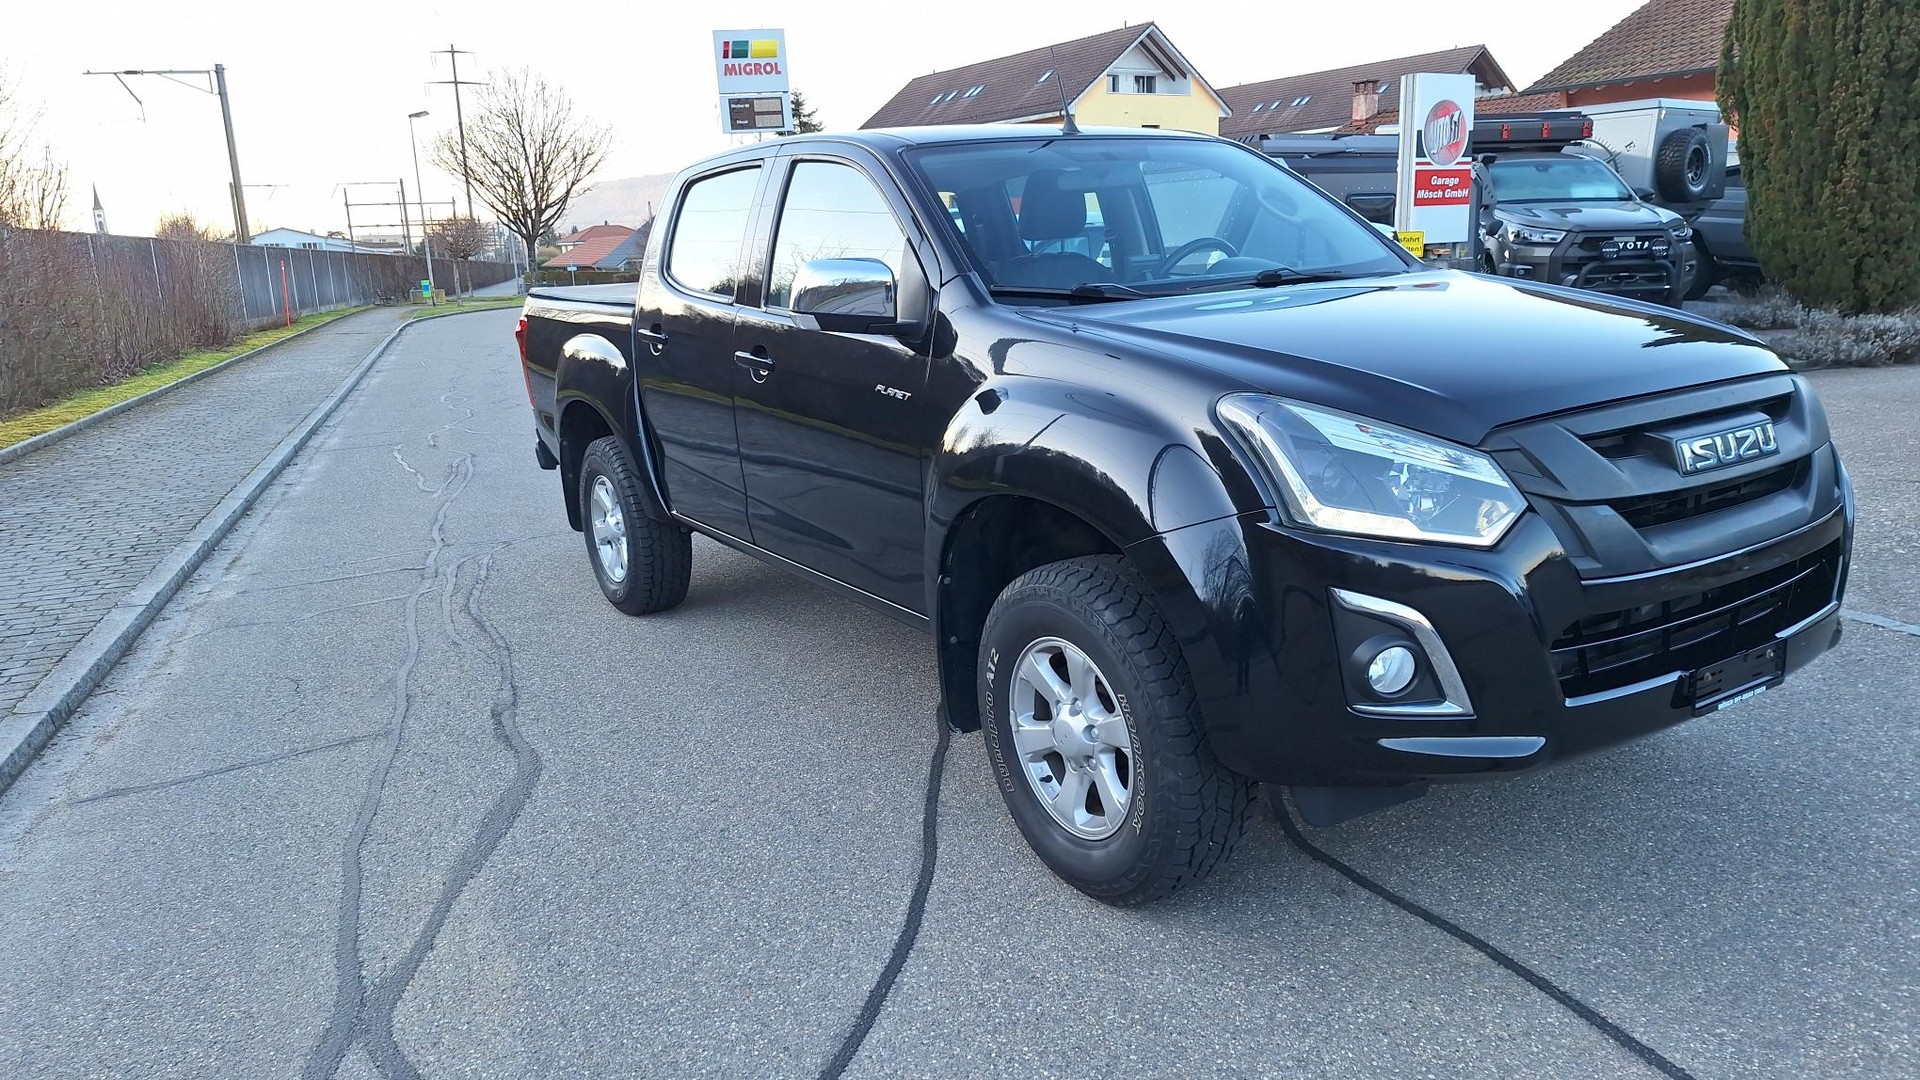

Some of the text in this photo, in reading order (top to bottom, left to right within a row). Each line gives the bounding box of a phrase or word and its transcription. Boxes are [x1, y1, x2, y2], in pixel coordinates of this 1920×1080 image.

[724, 62, 782, 76] MIGROL
[1430, 175, 1460, 187] Garage
[1416, 188, 1469, 199] Mösch GmbH
[1618, 241, 1650, 250] YOTA
[874, 384, 912, 401] PLANET
[1680, 423, 1778, 472] ISUZU
[985, 647, 1000, 689] AT2
